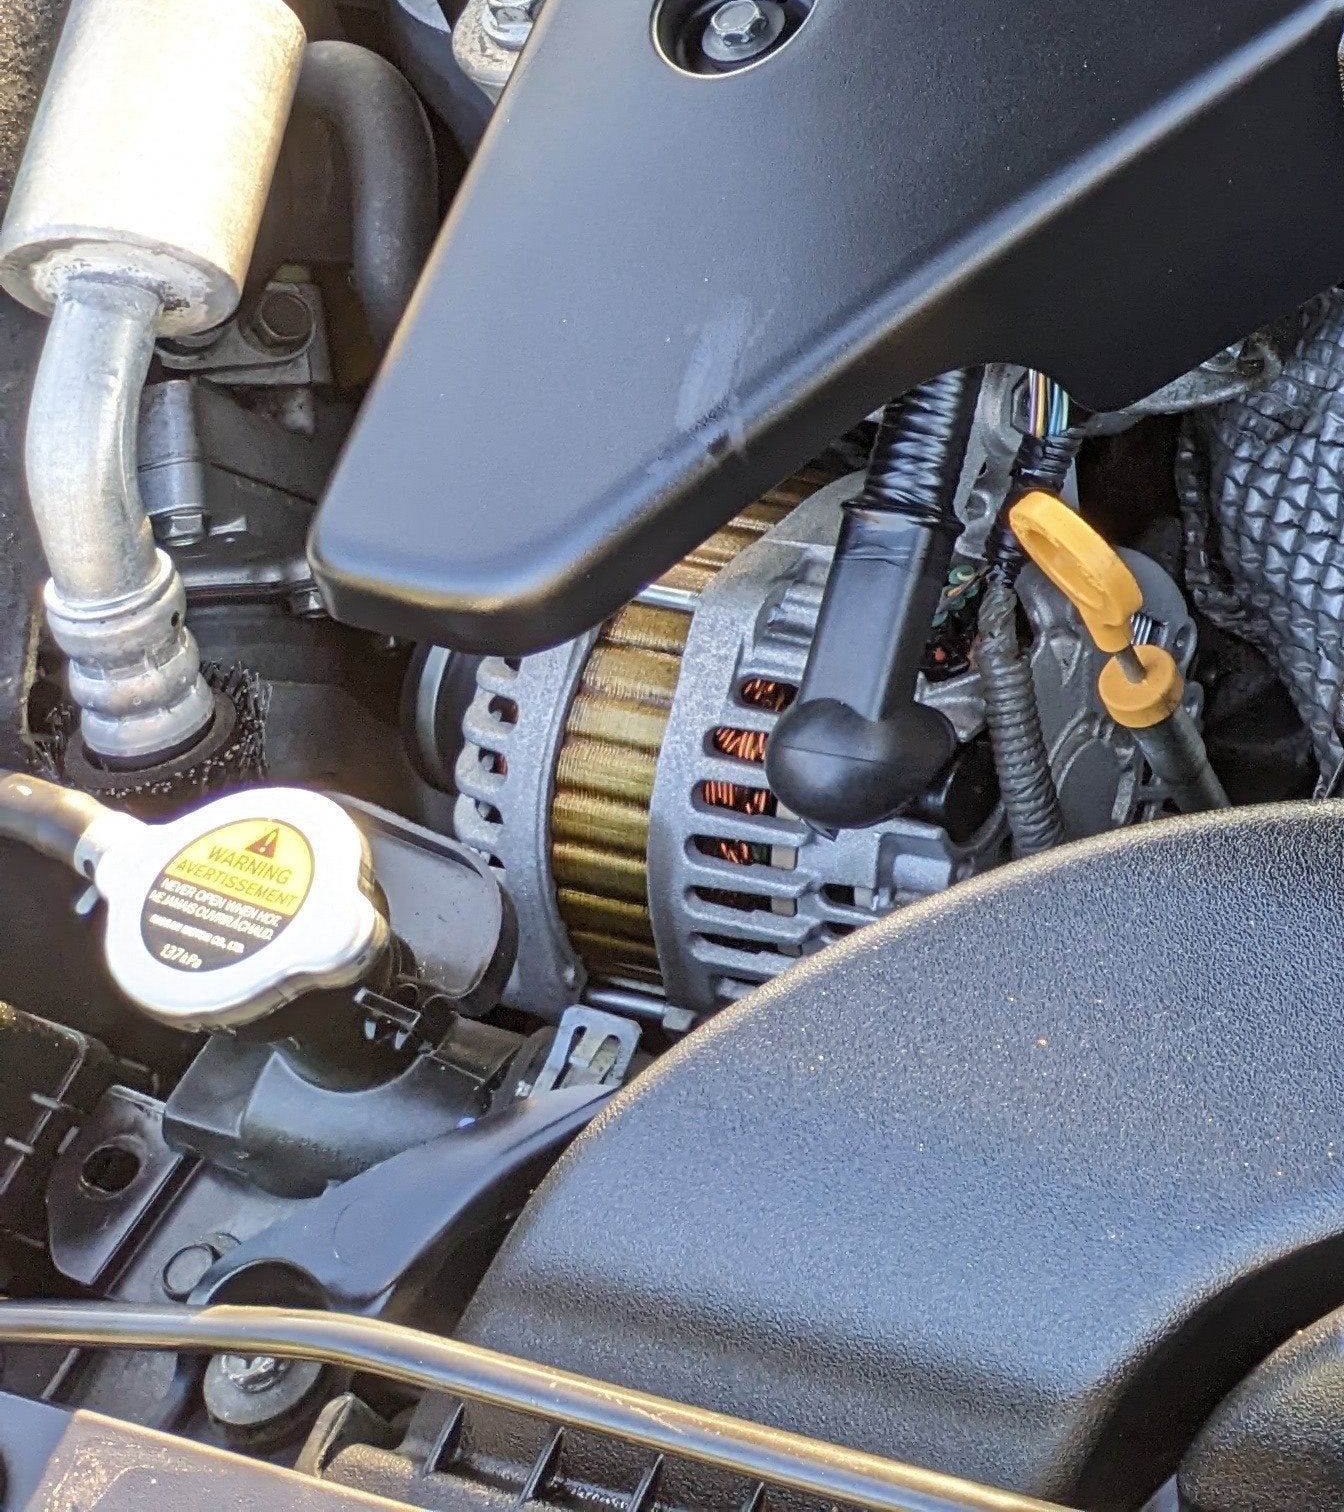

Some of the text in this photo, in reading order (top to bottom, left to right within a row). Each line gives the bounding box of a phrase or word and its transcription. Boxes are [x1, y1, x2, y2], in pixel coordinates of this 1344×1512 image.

[176, 859, 298, 907] AVERTISSEMENT
[208, 845, 292, 885] WARNING
[149, 889, 167, 904] NE
[160, 877, 198, 899] NEVER
[195, 888, 225, 909] OPEN
[223, 898, 259, 918] WHEN
